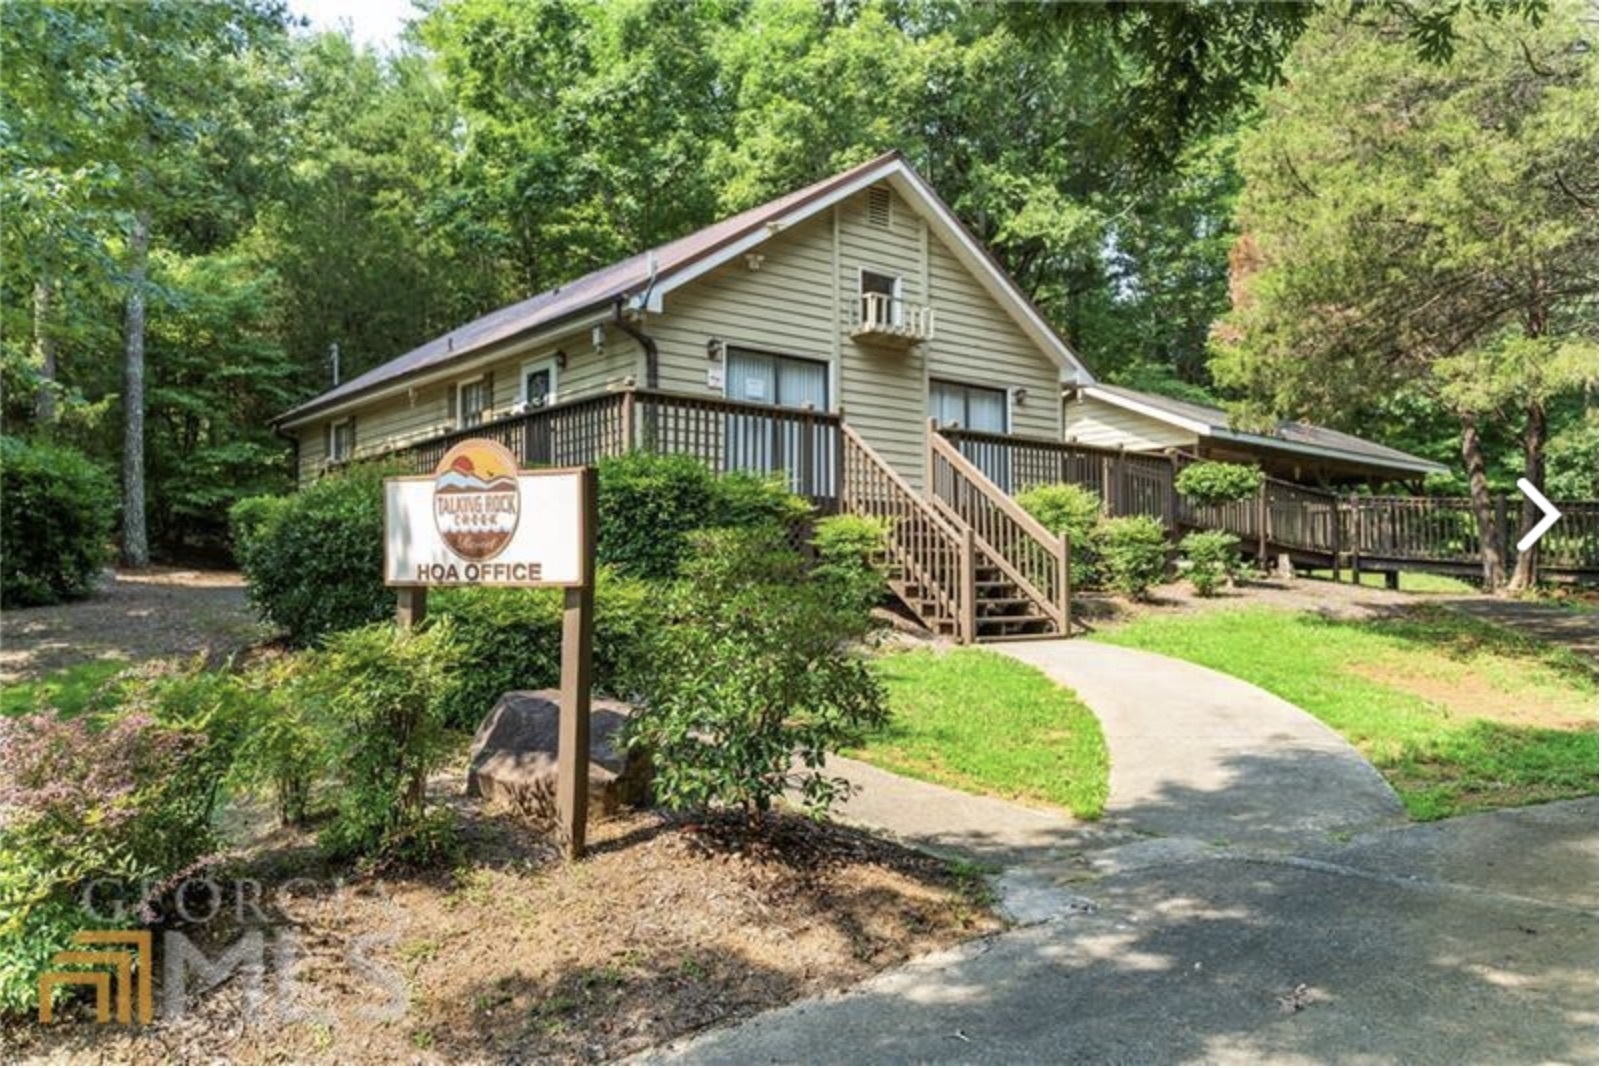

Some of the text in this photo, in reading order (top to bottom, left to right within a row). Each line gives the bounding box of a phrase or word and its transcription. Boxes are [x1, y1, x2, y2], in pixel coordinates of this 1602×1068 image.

[438, 494, 516, 515] TALKING ROCK
[454, 513, 498, 526] CREEK
[417, 563, 542, 581] HOA OFFICE
